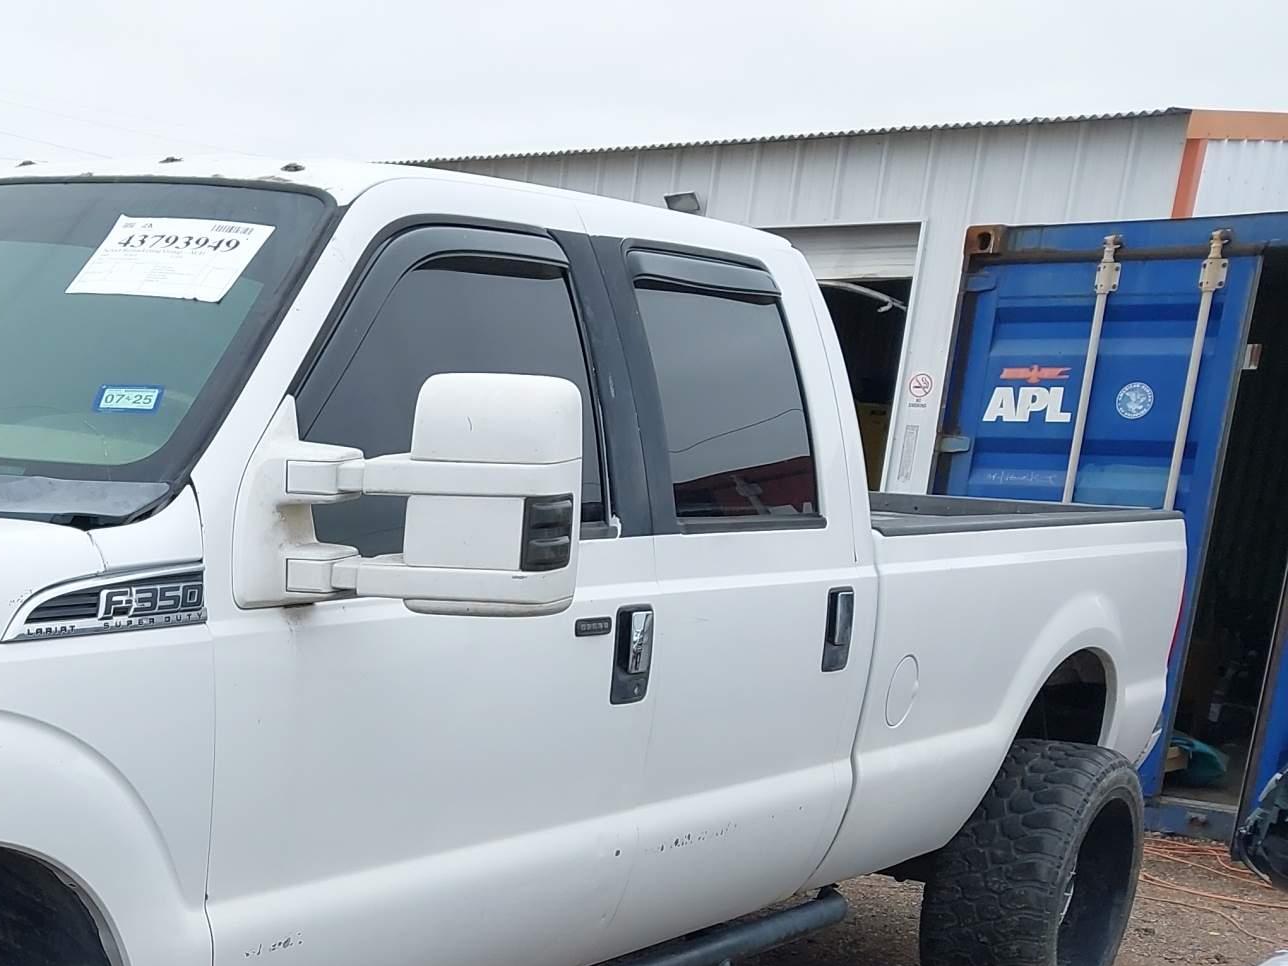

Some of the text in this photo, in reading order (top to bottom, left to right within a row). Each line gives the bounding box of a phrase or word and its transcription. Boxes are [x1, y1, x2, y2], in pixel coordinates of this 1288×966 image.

[118, 234, 241, 253] 43793949
[982, 386, 1072, 423] APL
[98, 583, 204, 620] F-350
[27, 612, 204, 636] LARIAT SUPER DUTY
